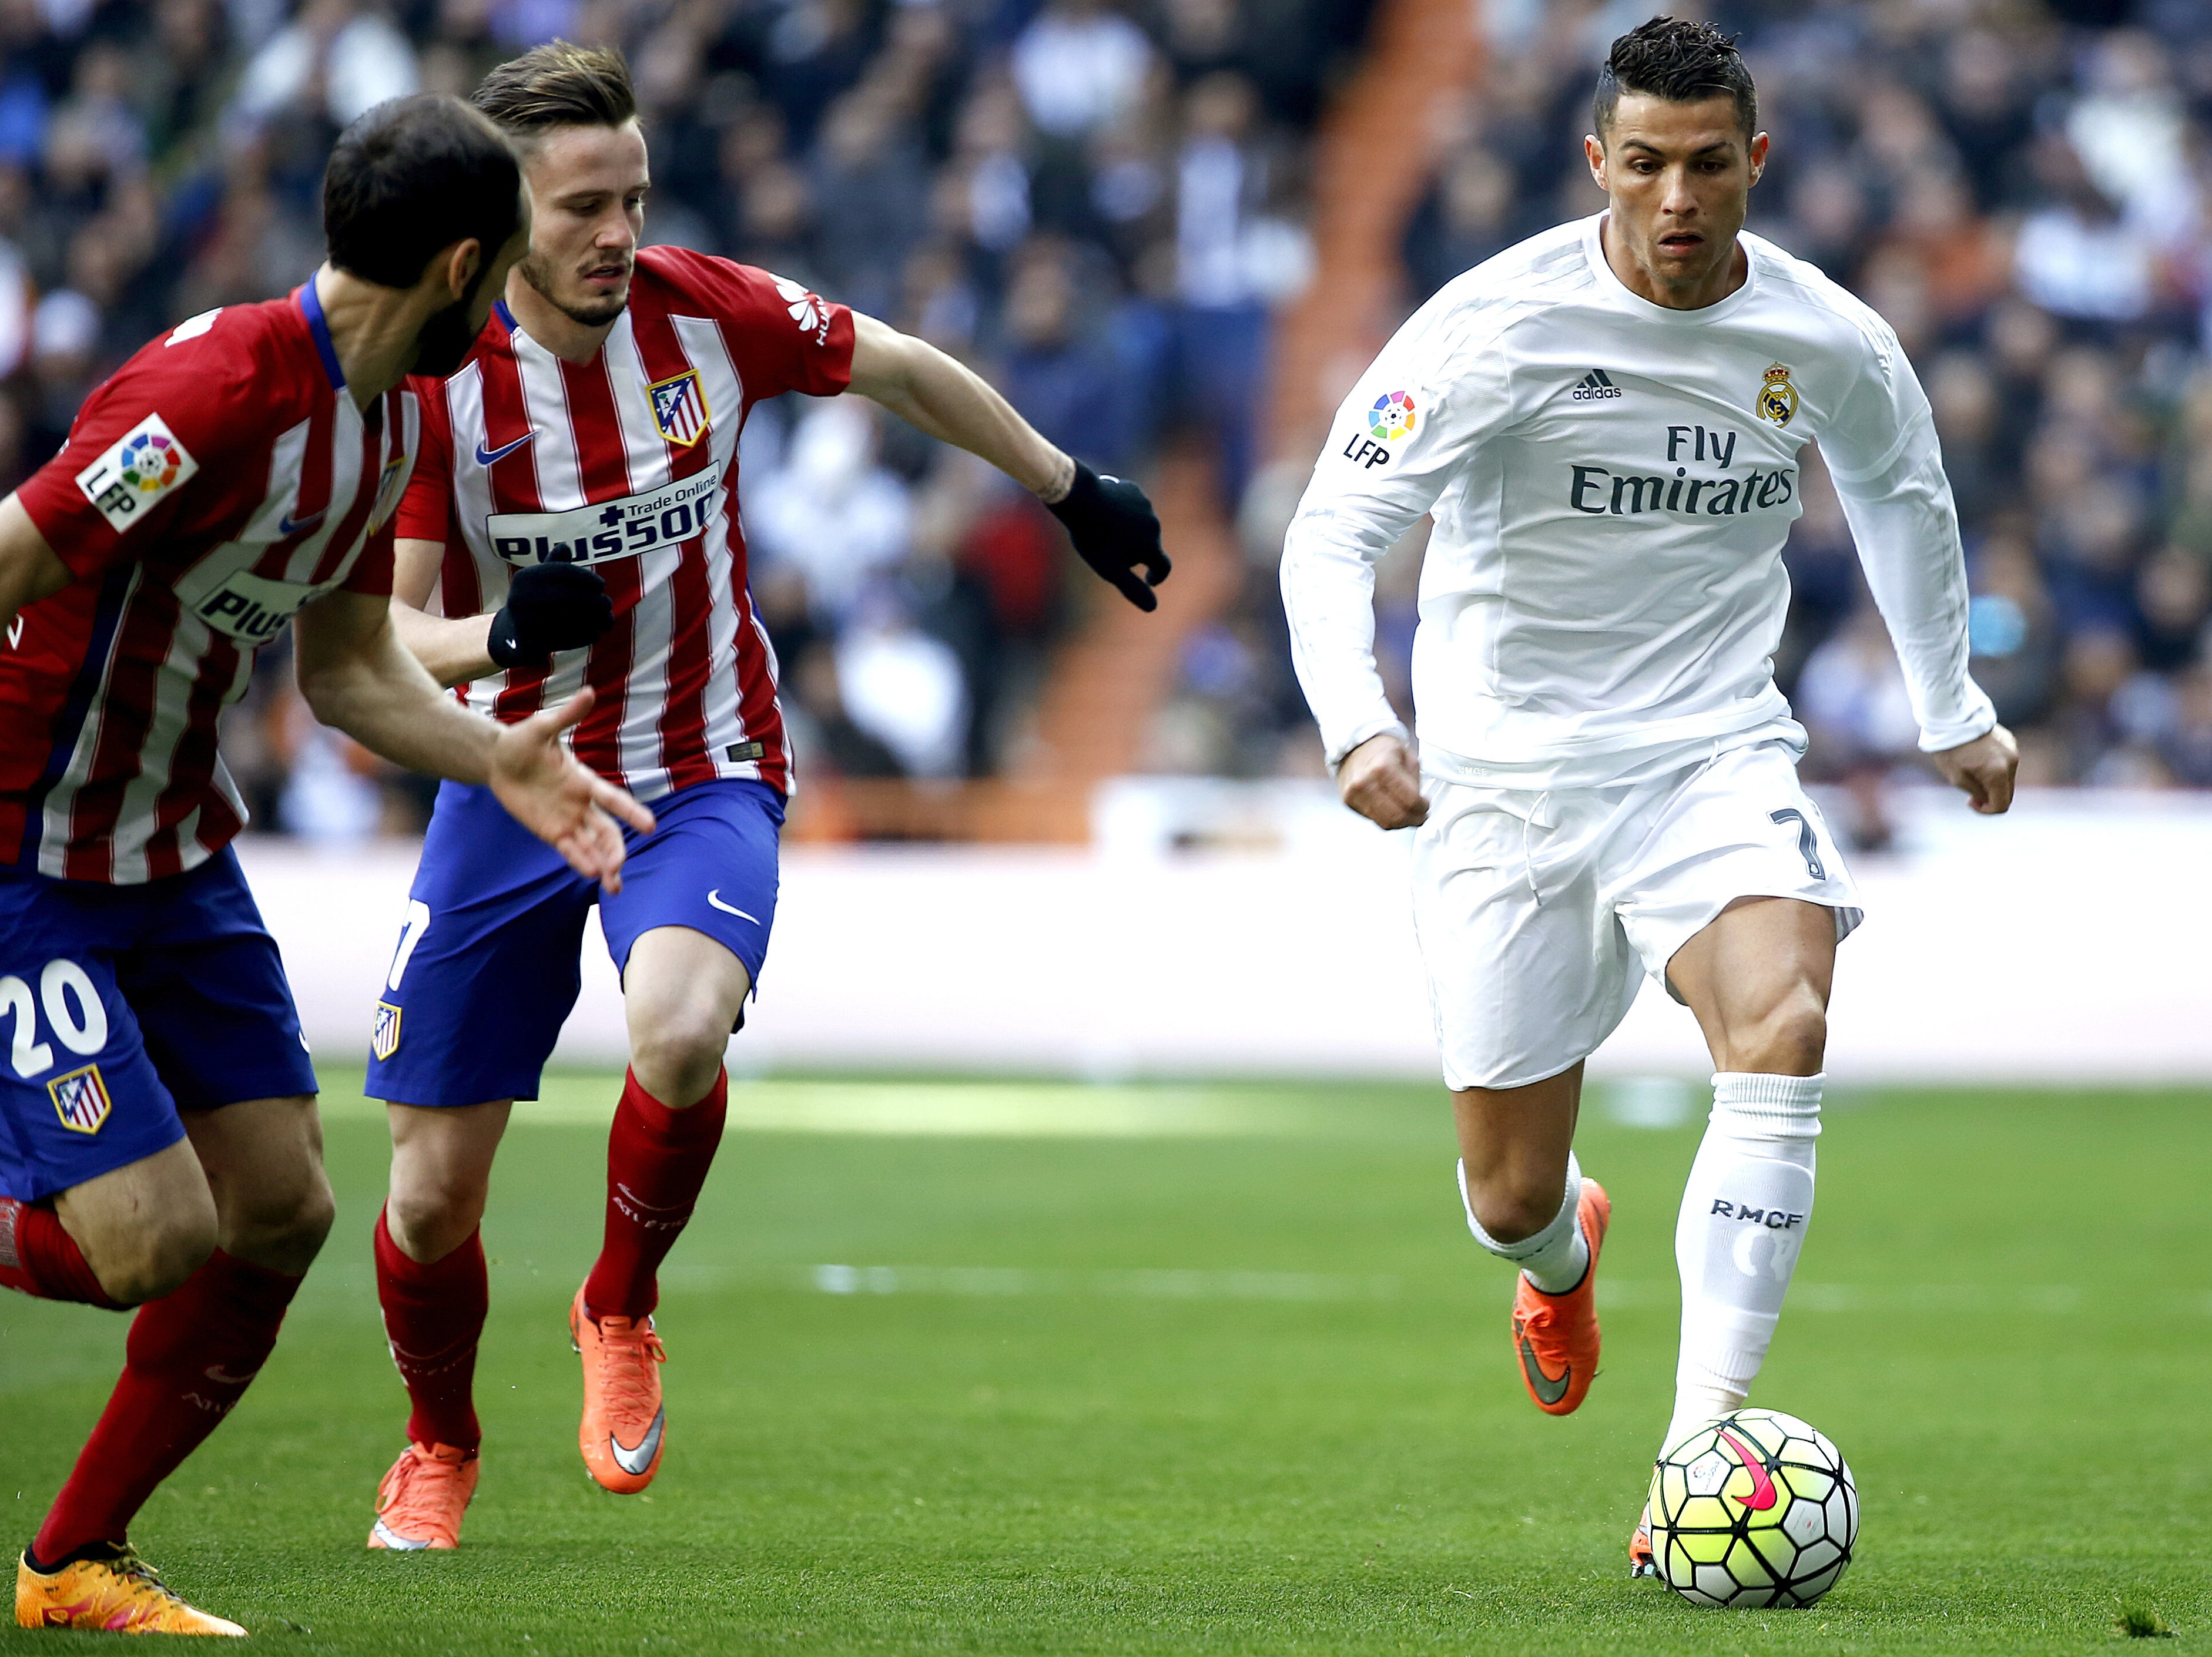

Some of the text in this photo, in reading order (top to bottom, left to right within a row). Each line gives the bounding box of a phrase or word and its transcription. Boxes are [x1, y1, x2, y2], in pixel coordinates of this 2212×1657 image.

[1573, 385, 1622, 400] adidas
[1343, 433, 1390, 469] LFP
[1667, 425, 1736, 469] Fly
[86, 468, 136, 514] LFP
[628, 475, 716, 516] Trade Online
[1570, 464, 1793, 516] Emirates
[1768, 807, 1826, 881] 7
[0, 958, 108, 1078] 20
[1710, 1199, 1803, 1229] RMCF
